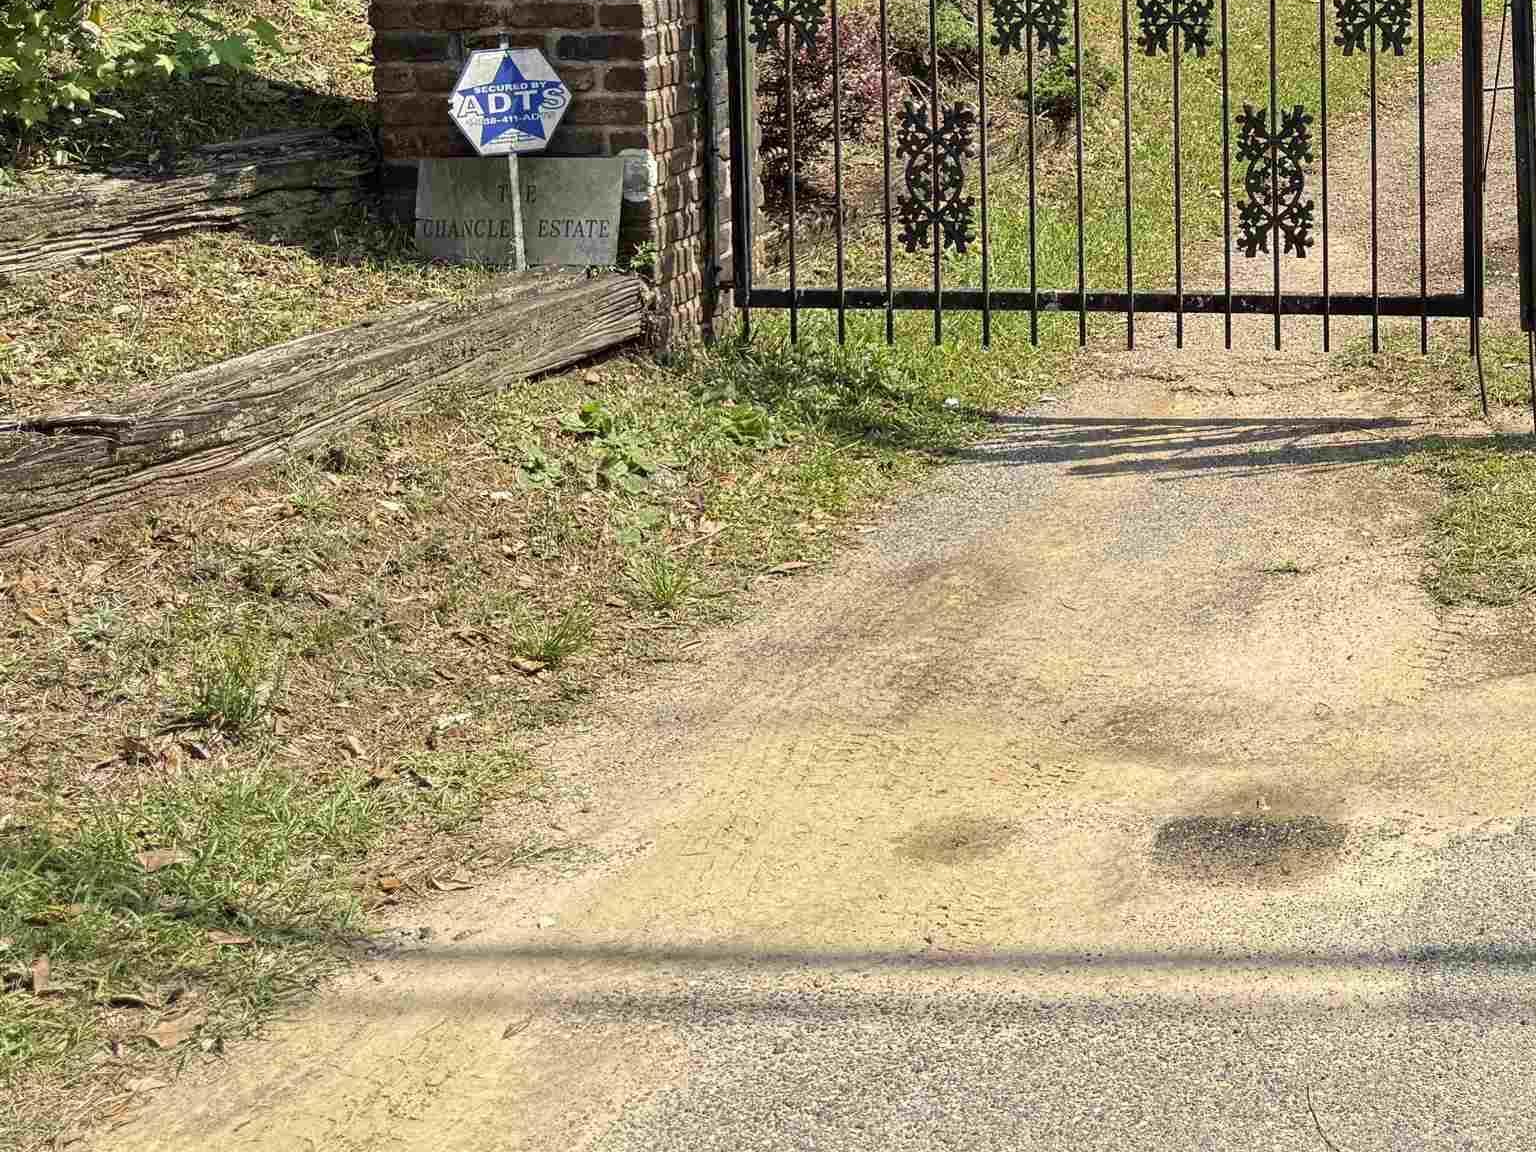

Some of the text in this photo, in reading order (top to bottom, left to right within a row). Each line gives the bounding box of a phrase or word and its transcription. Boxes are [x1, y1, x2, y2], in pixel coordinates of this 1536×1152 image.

[473, 81, 546, 94] SECURED BY
[457, 88, 567, 119] ADTS
[498, 185, 537, 203] TE
[424, 219, 610, 239] CHANCLE ESTATE
